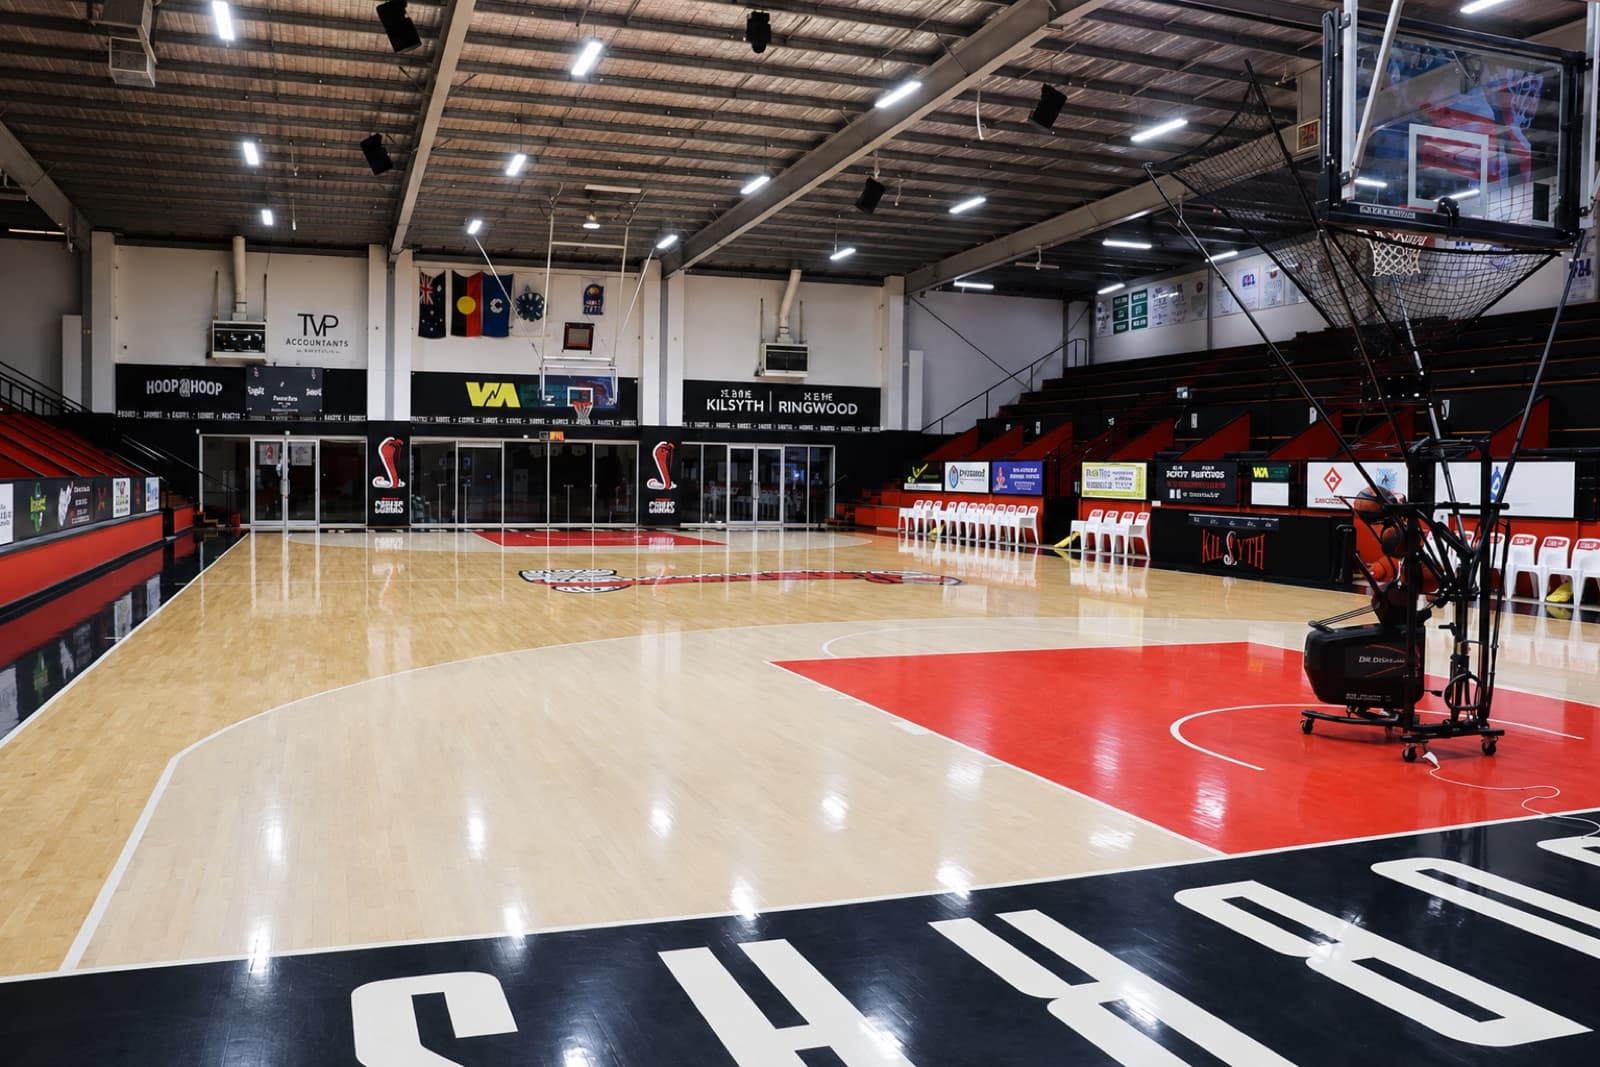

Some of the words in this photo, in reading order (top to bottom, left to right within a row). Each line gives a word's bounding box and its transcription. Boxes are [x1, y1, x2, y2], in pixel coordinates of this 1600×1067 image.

[297, 313, 339, 337] TVP
[286, 338, 349, 348] ACCOUNTANTS
[706, 398, 764, 413] KILSYTH
[778, 401, 859, 416] RINGWOOD
